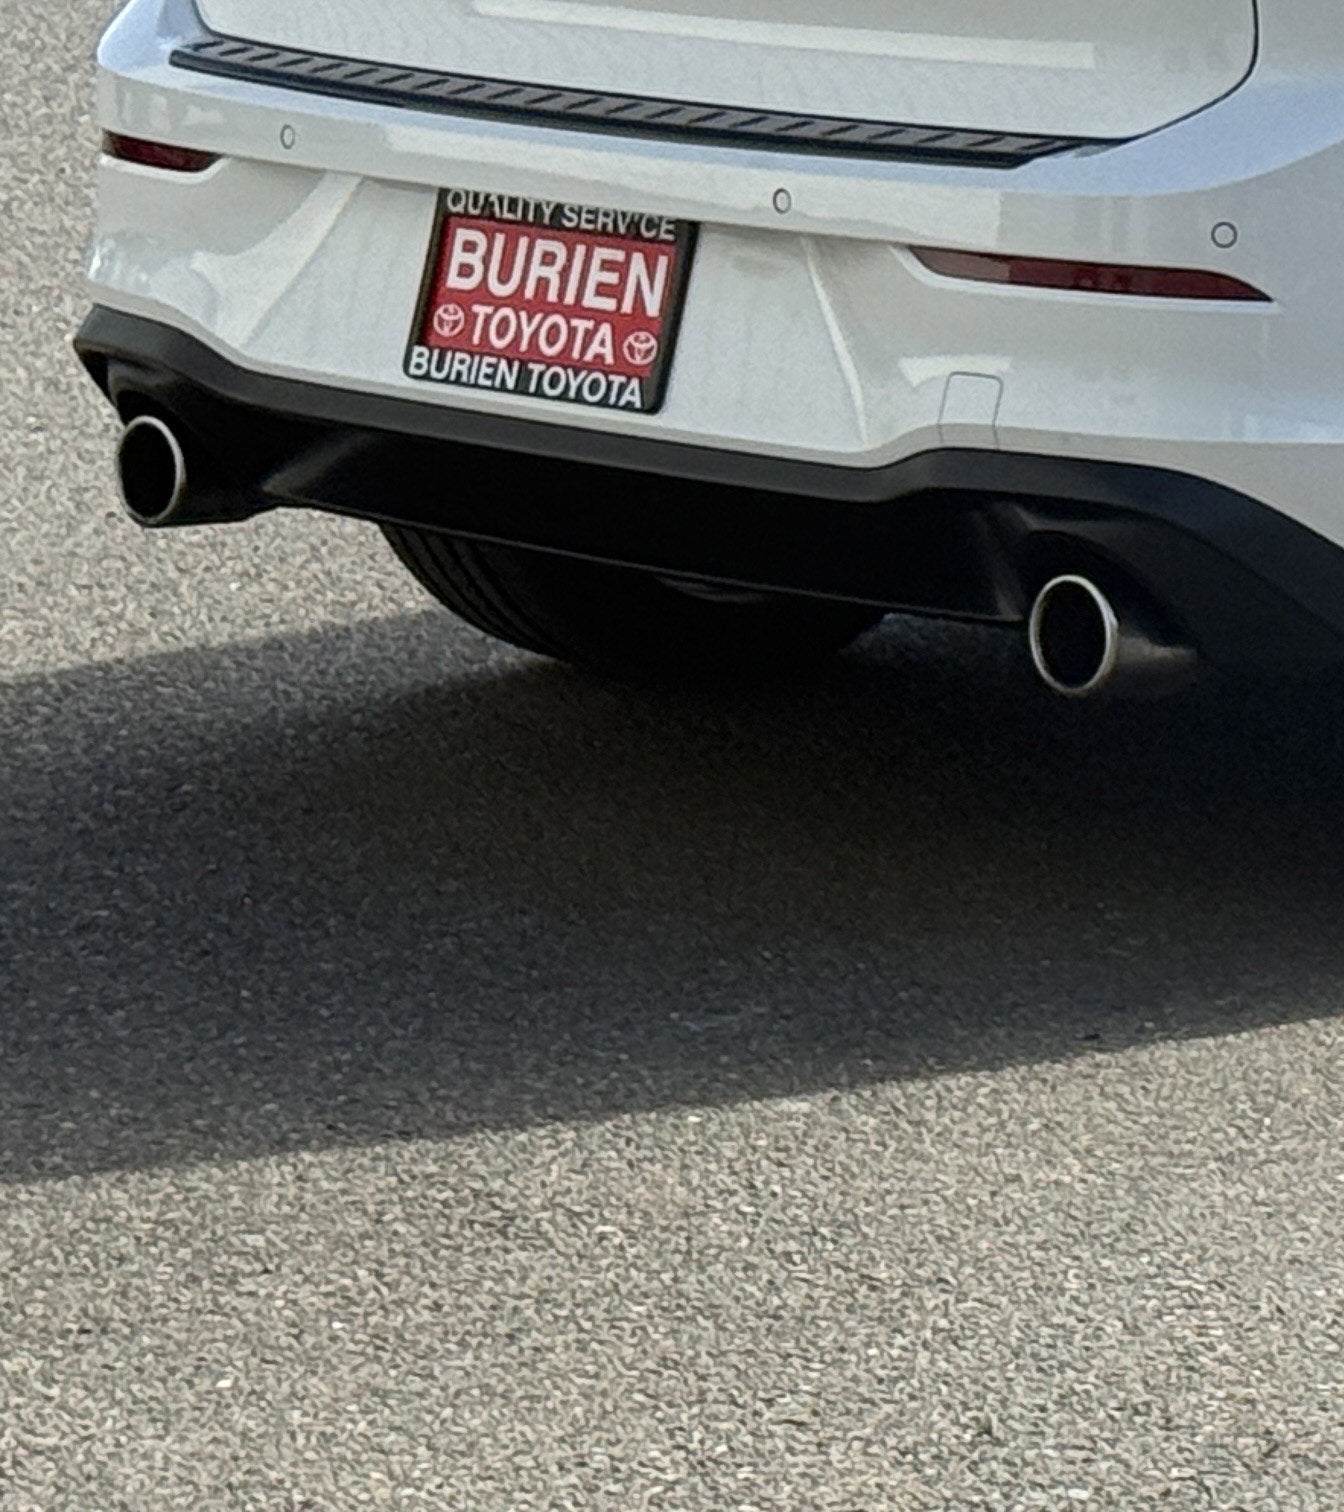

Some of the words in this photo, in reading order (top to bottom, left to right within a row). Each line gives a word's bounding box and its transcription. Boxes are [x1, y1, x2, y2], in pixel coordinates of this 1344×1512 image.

[446, 188, 557, 225] QUALITY
[445, 227, 669, 318] BURIEN
[471, 303, 614, 366] TOYOTA
[408, 346, 520, 390] BURIEN
[522, 363, 643, 408] TOYOTA
